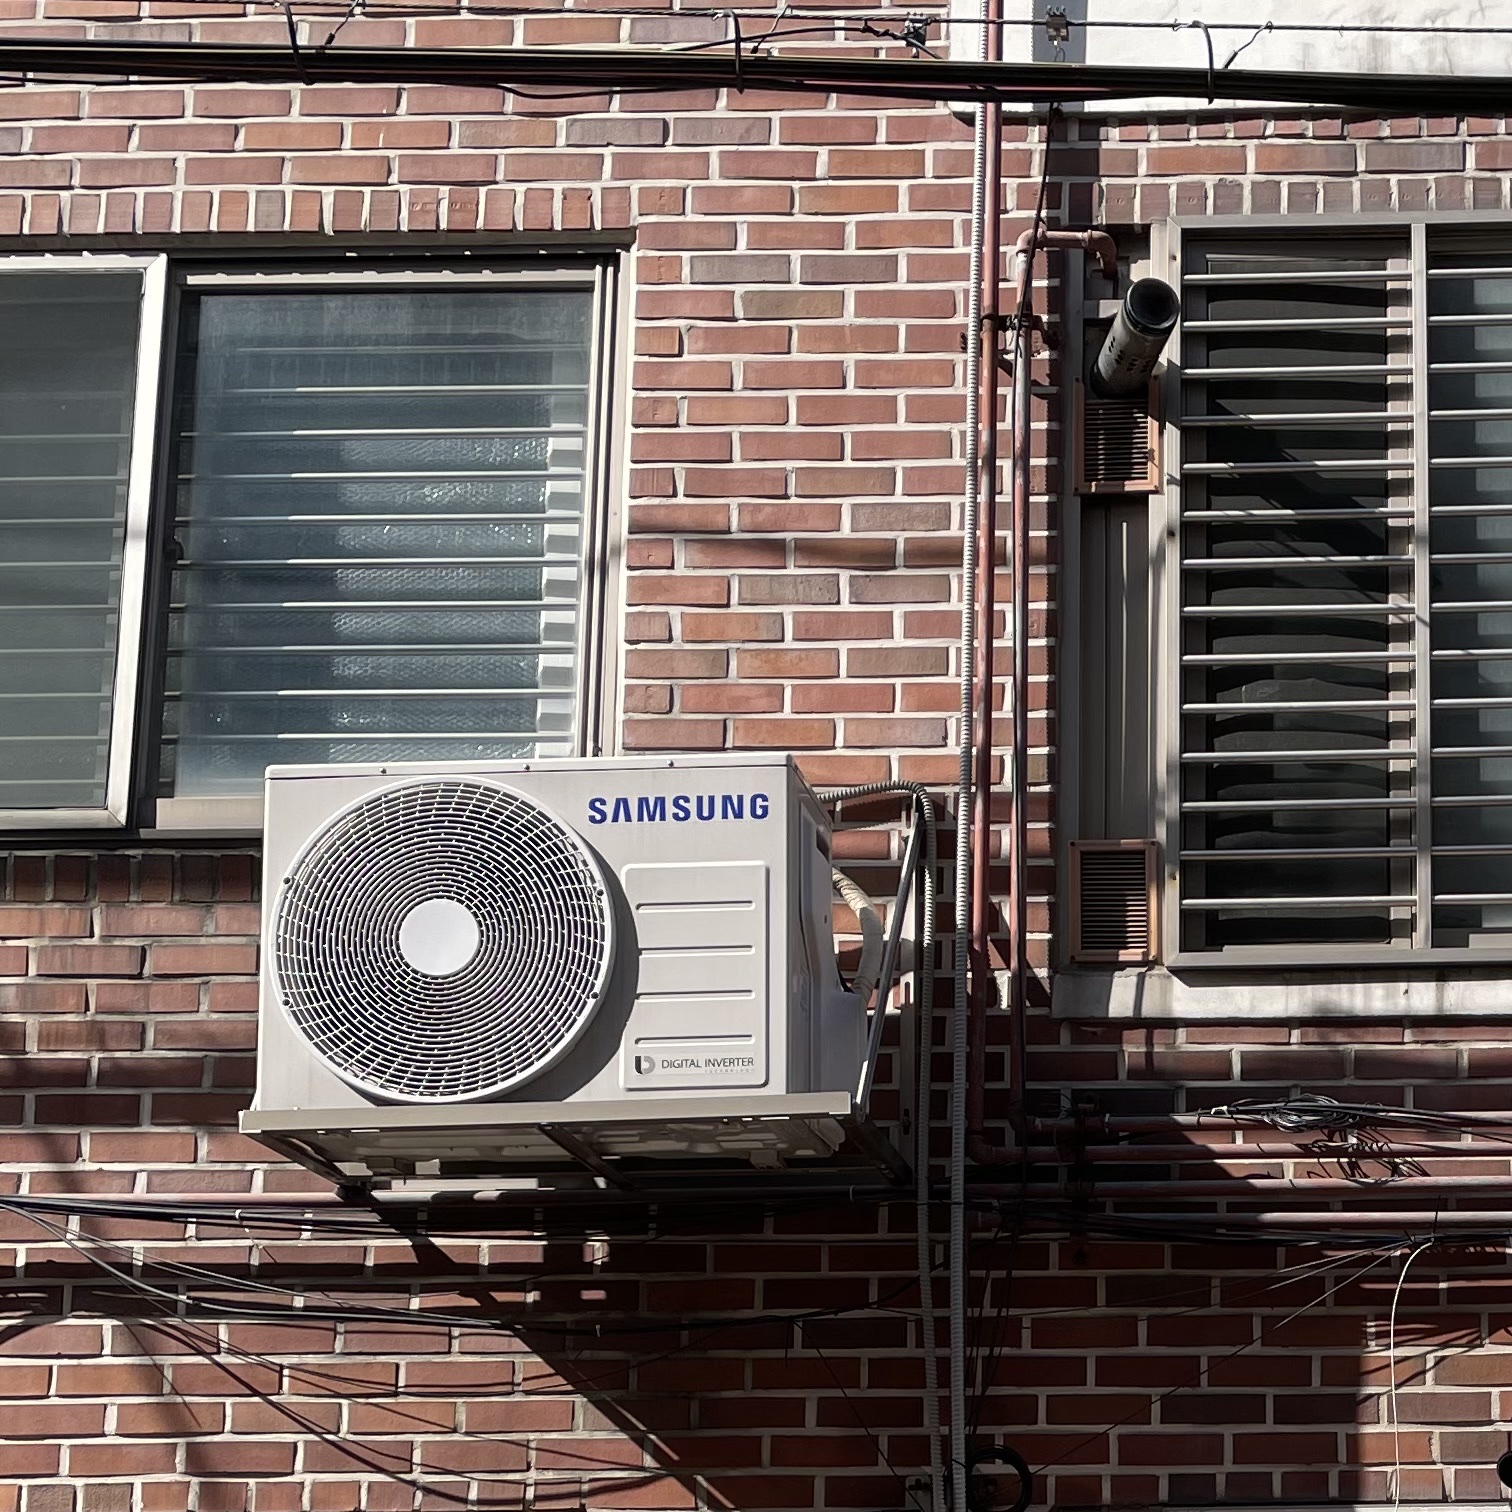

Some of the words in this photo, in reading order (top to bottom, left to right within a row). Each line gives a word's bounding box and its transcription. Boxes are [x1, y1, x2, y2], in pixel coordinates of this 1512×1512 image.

[588, 793, 769, 824] SAMSUNG
[661, 1058, 702, 1069] DIGITAL
[704, 1057, 755, 1068] INVERTER
